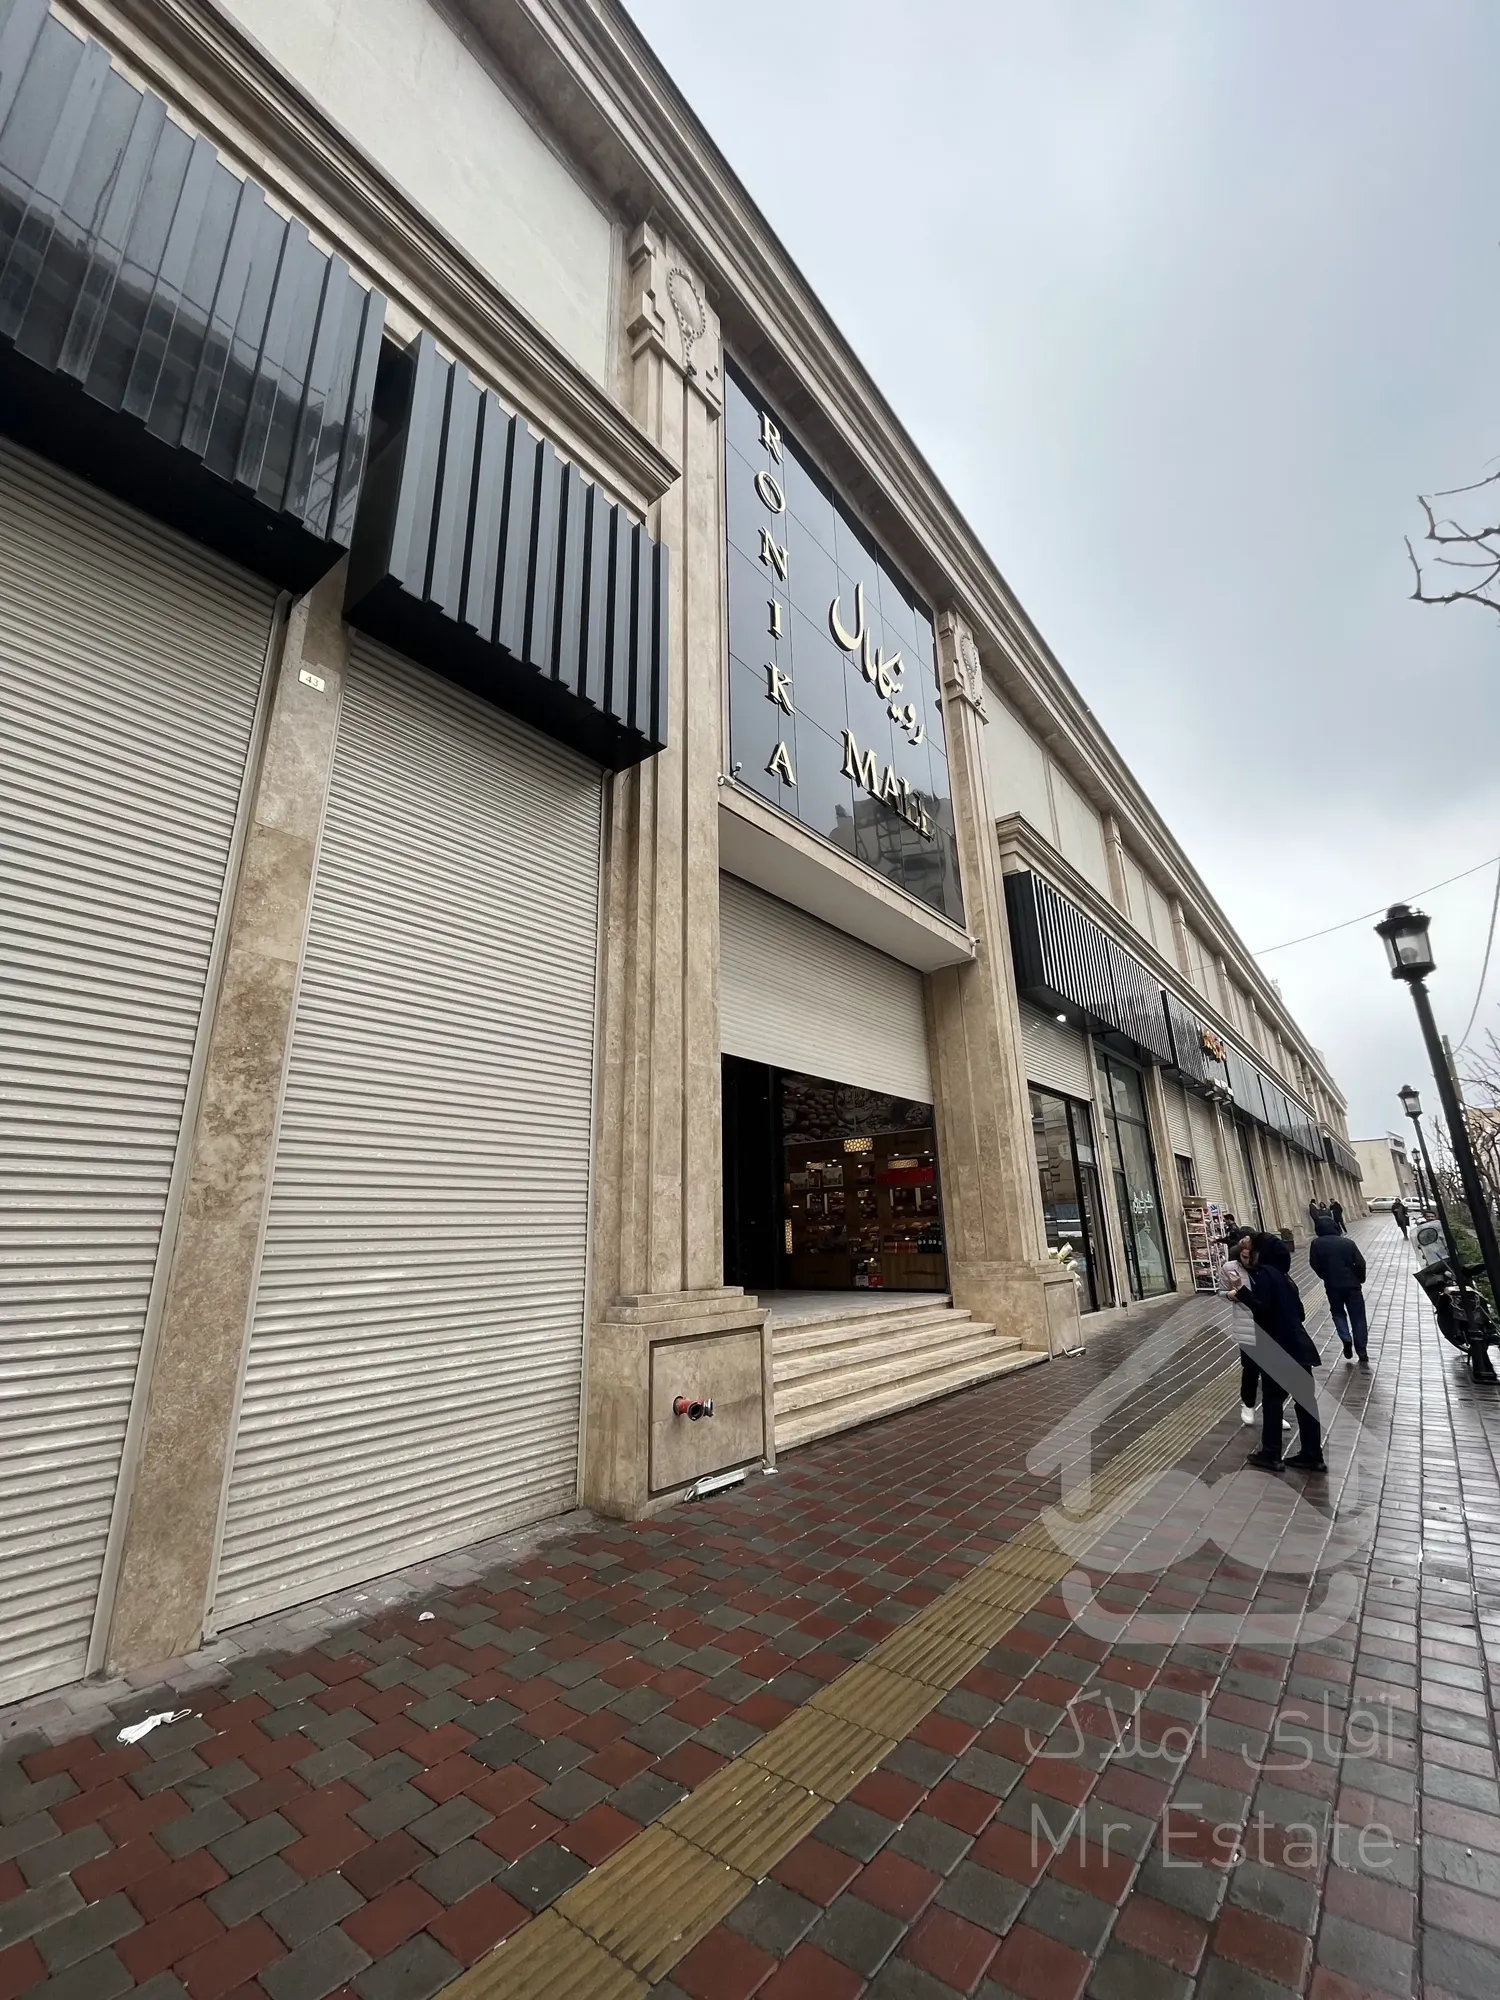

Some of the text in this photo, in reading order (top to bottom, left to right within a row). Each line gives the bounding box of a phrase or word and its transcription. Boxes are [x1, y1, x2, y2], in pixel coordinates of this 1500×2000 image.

[754, 410, 796, 788] RONIKA
[305, 676, 319, 687] 43
[840, 728, 935, 842] MALL
